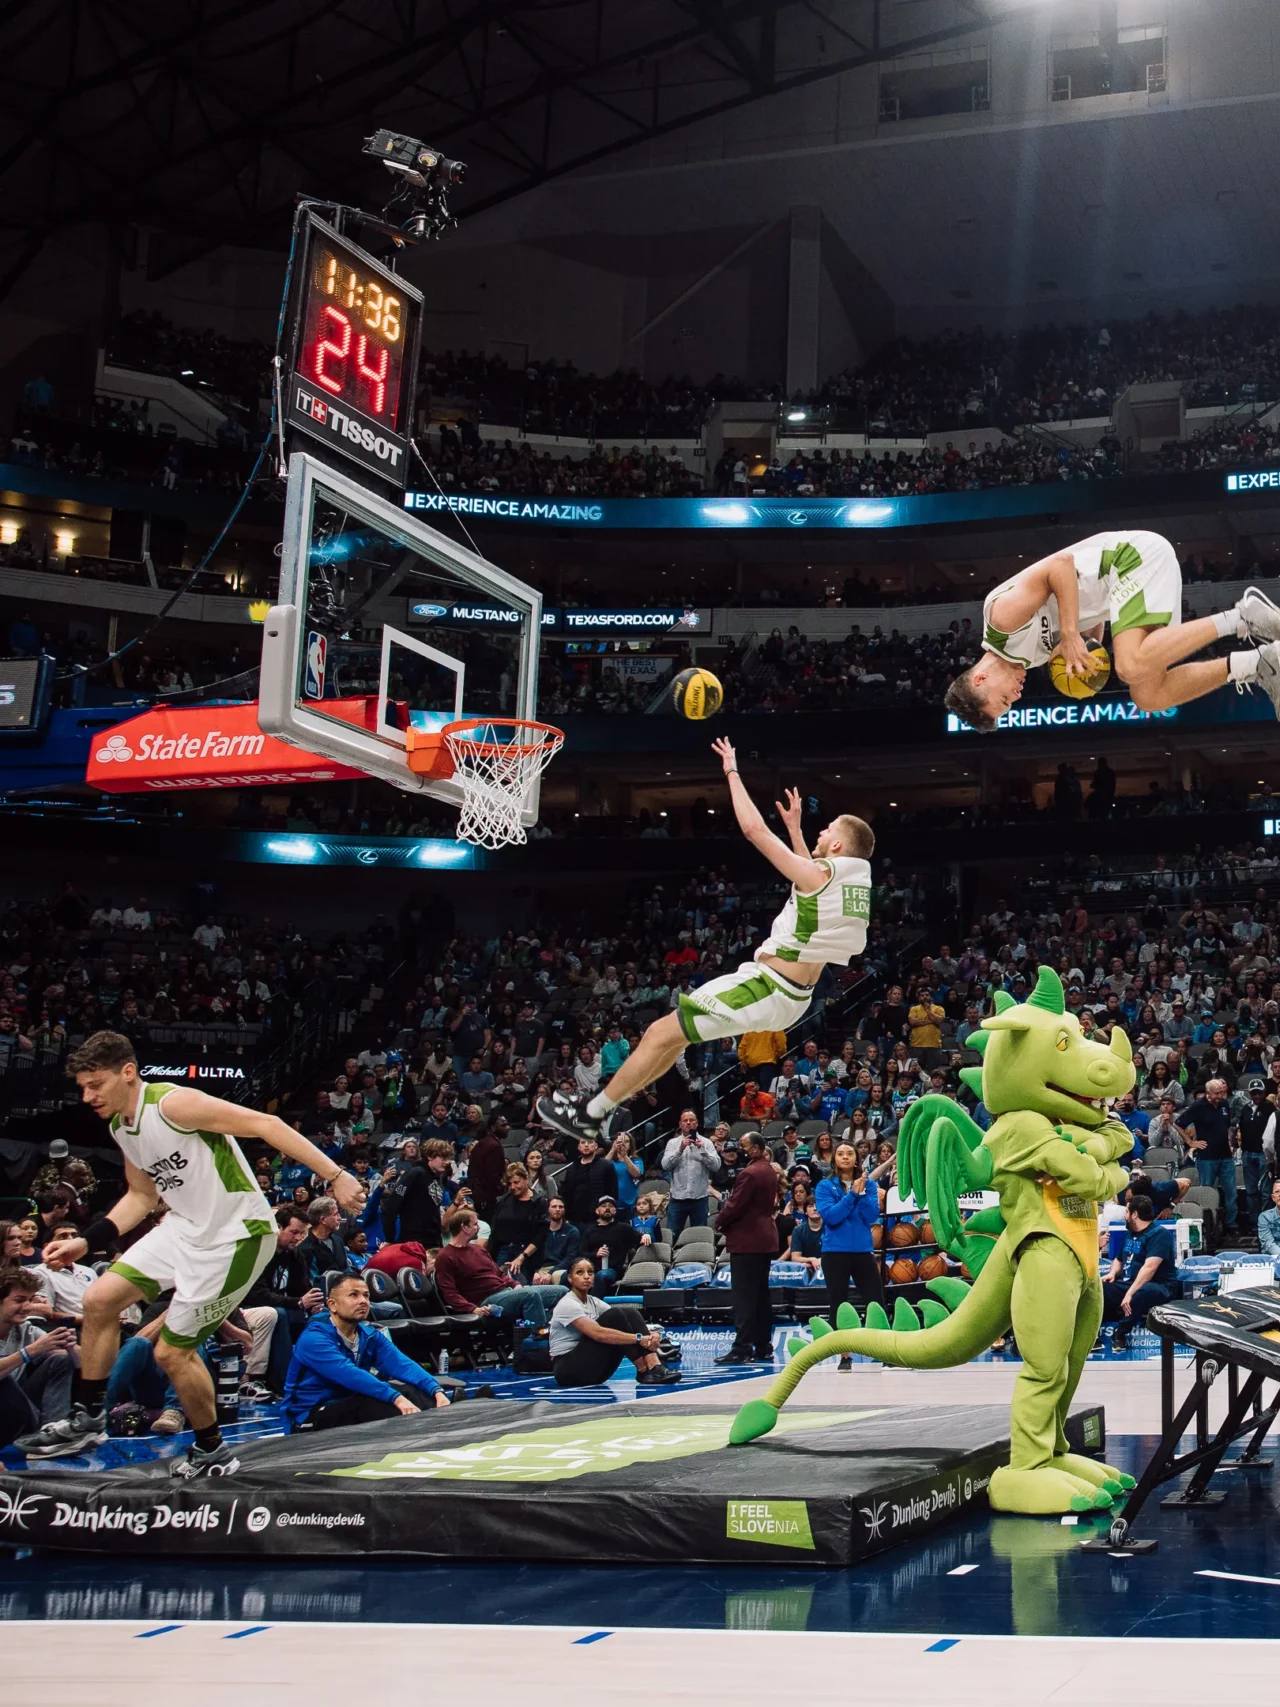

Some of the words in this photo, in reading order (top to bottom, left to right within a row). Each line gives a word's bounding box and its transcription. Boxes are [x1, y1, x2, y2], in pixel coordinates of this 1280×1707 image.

[326, 257, 401, 342] 11:36
[314, 304, 389, 413] 24
[328, 406, 403, 467] TISSOT
[415, 493, 519, 516] EXPERIENCE
[521, 503, 604, 521] AMAZING
[453, 607, 520, 622] MUSTANG
[567, 613, 675, 626] TEXASFORD.COM
[961, 705, 1079, 731] ERIENCE
[852, 887, 869, 899] FEE
[140, 1065, 188, 1077] Michelob
[199, 1067, 244, 1079] ULTRA
[203, 1297, 234, 1314] FEEL
[666, 1329, 737, 1342] Southweste
[680, 1341, 716, 1351] Medical
[739, 1504, 773, 1518] FEEL
[892, 1496, 931, 1529] Dunking
[931, 1485, 957, 1513] Devils
[49, 1502, 149, 1536] Dunking
[151, 1503, 220, 1534] Devils
[276, 1512, 366, 1529] @dunkingdevils
[730, 1519, 800, 1535] SLOVENIA
